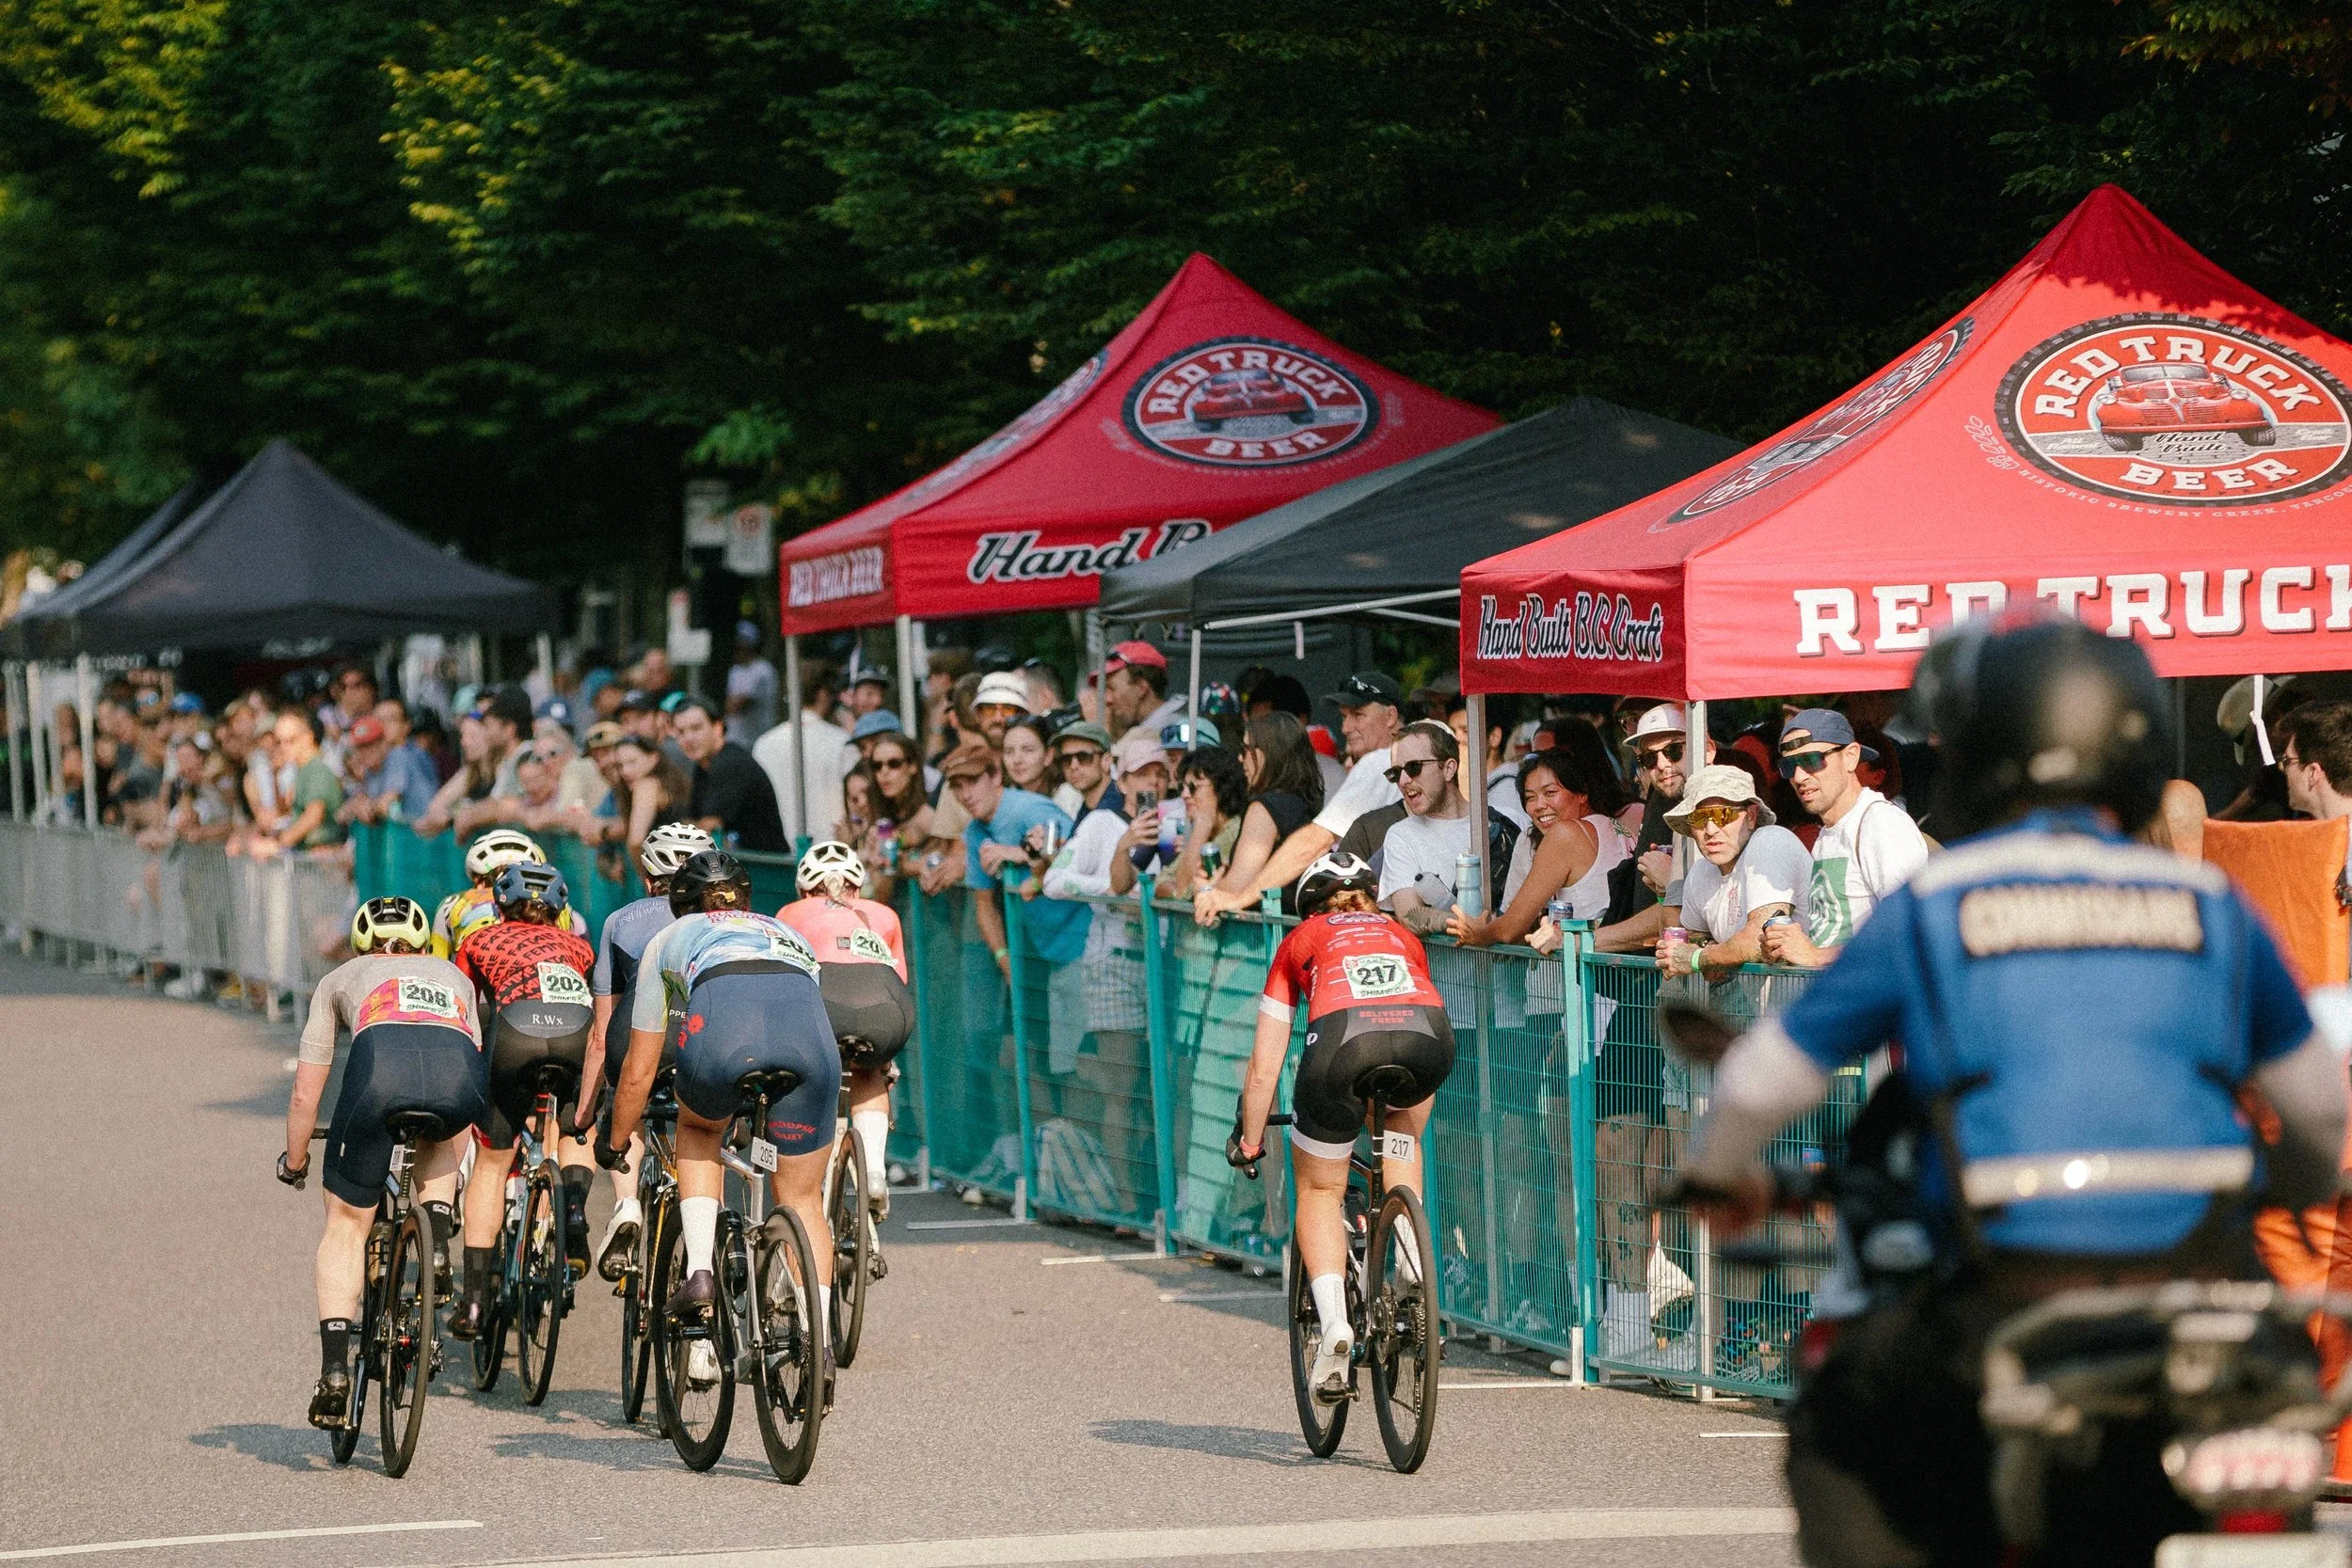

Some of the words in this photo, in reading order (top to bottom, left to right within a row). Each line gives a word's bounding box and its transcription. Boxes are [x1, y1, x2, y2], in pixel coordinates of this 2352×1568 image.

[1148, 363, 1211, 415] RED
[1209, 350, 1347, 399] TRUCK
[2034, 348, 2121, 418] RED
[2120, 336, 2323, 412] TRUCK
[1204, 431, 1327, 458] BEER
[2153, 432, 2227, 443] Hand
[2161, 442, 2228, 453] Built
[2119, 458, 2298, 490] BEER
[2018, 469, 2100, 504] HISTORIC
[2107, 501, 2202, 517] BREWERY
[967, 528, 1151, 584] Hand
[1477, 594, 1527, 659] Hand
[1526, 593, 1571, 658] Built
[1610, 594, 1663, 662] Craft
[1358, 964, 1395, 985] 217
[406, 984, 447, 1008] 208
[1359, 1009, 1415, 1018] DELIVERED
[760, 1146, 773, 1165] 205
[1391, 1138, 1409, 1157] 217
